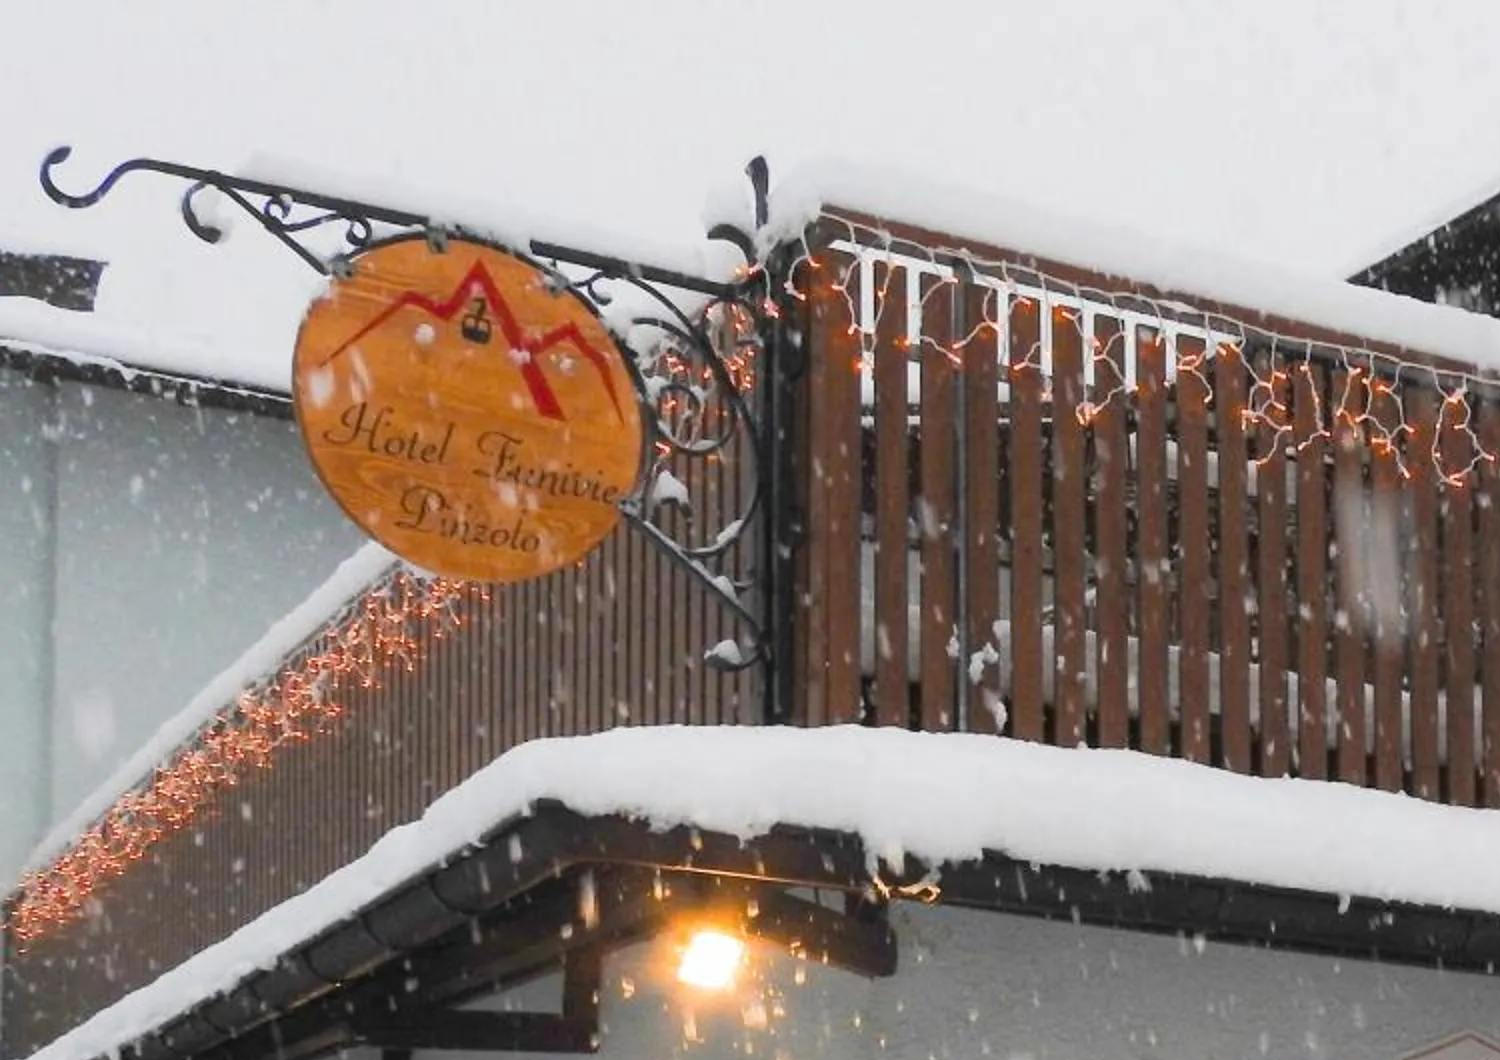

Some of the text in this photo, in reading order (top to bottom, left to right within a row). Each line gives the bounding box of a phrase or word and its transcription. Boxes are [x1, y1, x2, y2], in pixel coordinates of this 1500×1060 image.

[322, 401, 619, 505] Hotel Funivie
[394, 483, 541, 553] Pinzolo
